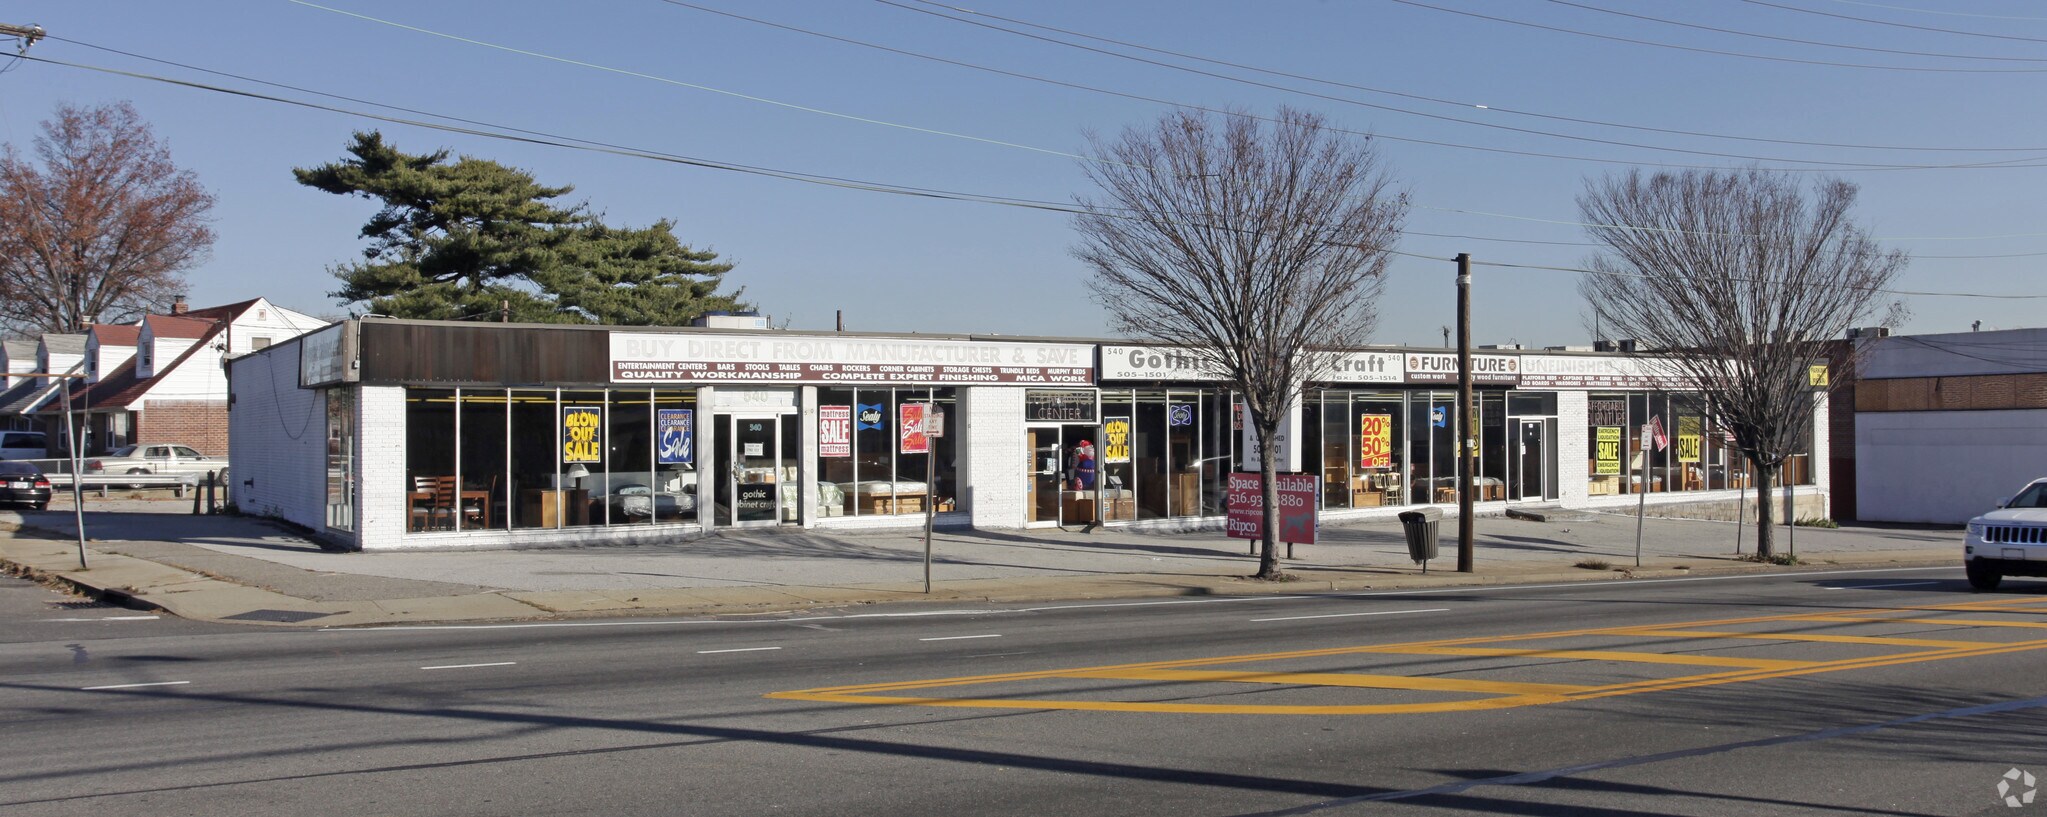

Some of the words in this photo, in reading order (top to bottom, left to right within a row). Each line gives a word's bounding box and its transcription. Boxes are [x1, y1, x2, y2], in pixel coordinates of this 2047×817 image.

[626, 339, 674, 359] BUY
[688, 340, 761, 359] DIRECT
[773, 341, 833, 360] FROM
[846, 343, 1001, 363] MANUFACTURER
[1012, 346, 1026, 364] &
[1036, 347, 1078, 364] SAVE
[618, 362, 675, 370] ENTERTAINMENT
[1128, 349, 1212, 369] Gothic
[1331, 353, 1385, 372] Craft
[1421, 357, 1506, 371] FURNTURE
[621, 371, 684, 379] QUALITY
[691, 371, 802, 380] WORKMANSHIP
[822, 372, 885, 380] COMPLETE
[890, 373, 933, 381] EXPERT
[744, 391, 768, 402] 540
[565, 411, 599, 427] BLOW
[821, 410, 849, 418] mattress
[860, 410, 881, 424] Sealy
[904, 408, 923, 422] Sal
[1037, 407, 1081, 419] CENTER
[570, 426, 595, 441] OUT
[749, 424, 762, 432] 540
[821, 420, 849, 443] SALE
[902, 419, 923, 439] Sal
[1105, 421, 1128, 434] BLOW
[1362, 417, 1390, 436] 20%
[660, 426, 691, 458] Sale
[1109, 433, 1126, 445] OUT
[1362, 436, 1390, 456] 50%
[565, 442, 599, 461] SALE
[821, 445, 849, 453] mattress
[1106, 445, 1129, 460] SALE
[1598, 442, 1618, 460] SALE
[1680, 438, 1698, 458] SALE
[1372, 457, 1389, 467] OFF
[1229, 476, 1259, 491] Space
[1276, 478, 1313, 492] ailable
[742, 489, 766, 501] gothic
[737, 499, 759, 508] binet
[1228, 517, 1257, 536] Ripco
